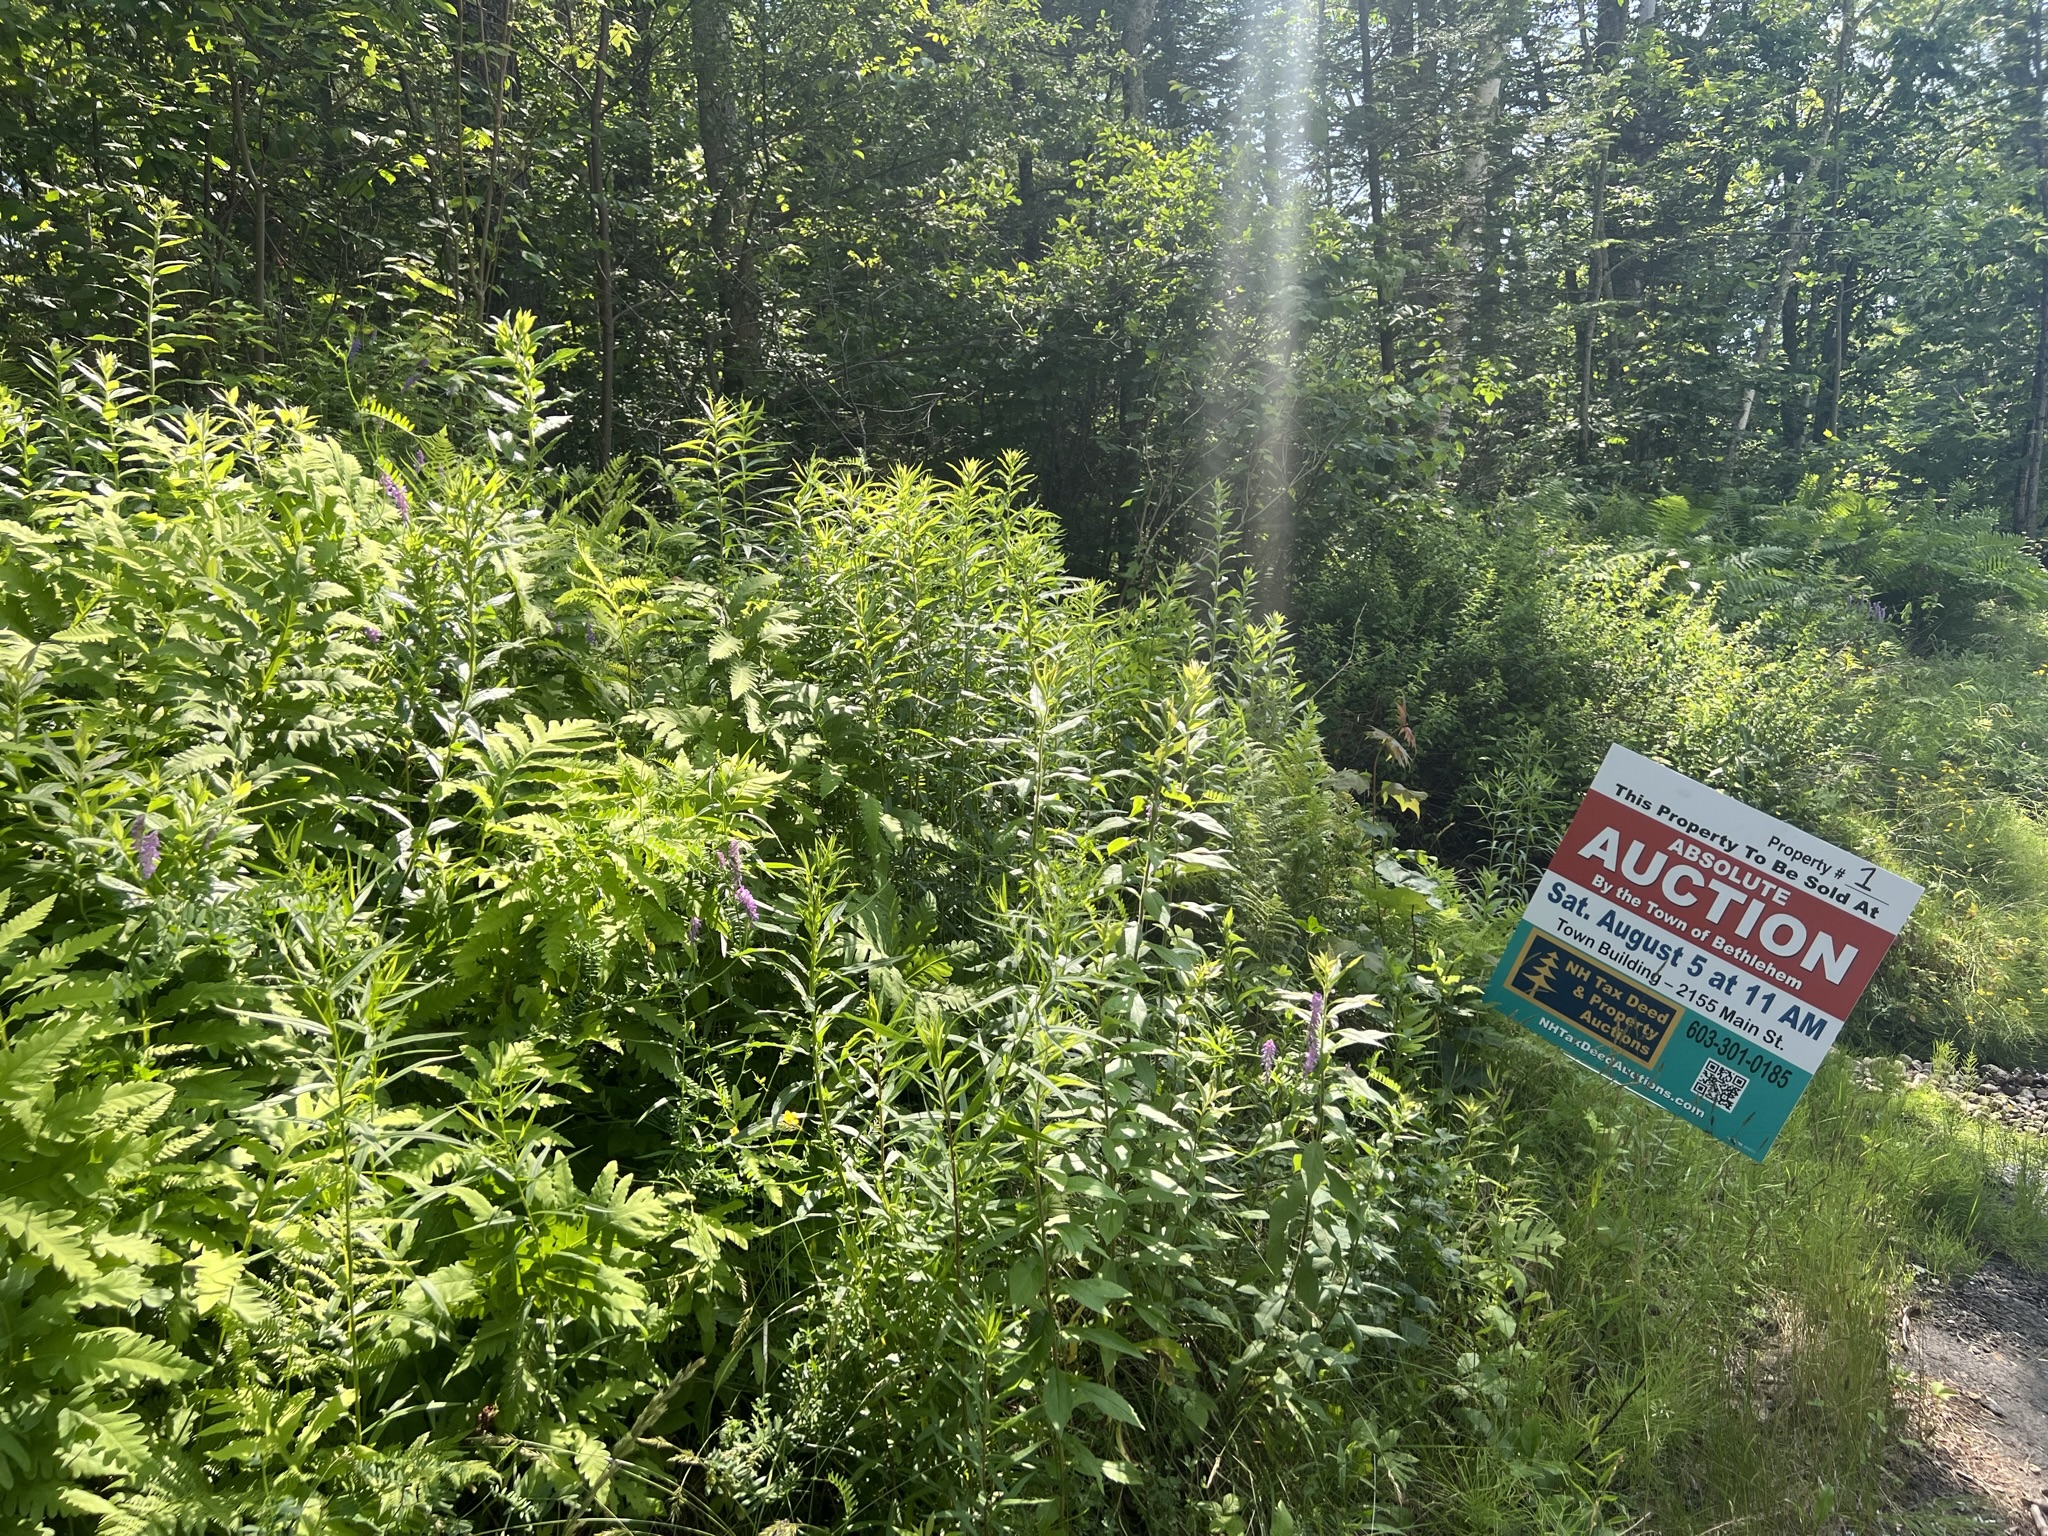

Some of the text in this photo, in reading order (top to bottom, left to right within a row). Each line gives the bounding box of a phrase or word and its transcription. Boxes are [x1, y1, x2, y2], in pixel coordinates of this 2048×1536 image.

[1615, 783, 1880, 919] This Property To Be Sold At
[1667, 838, 1791, 906] ABSOLUTE
[1767, 836, 1846, 879] Property #
[1854, 867, 1877, 892] 1
[1577, 825, 1859, 986] AUCTION
[1591, 873, 1803, 991] By the Town of Bethlehem
[1547, 881, 1828, 1041] Sat. August 5 at 11 AM
[1556, 917, 1595, 949] Town
[1597, 941, 1662, 986] Building
[1676, 983, 1719, 1013] 2155
[1718, 1005, 1760, 1037] Main
[1762, 1030, 1784, 1051] St.
[1565, 960, 1670, 1025] NH Tax Deed
[1572, 985, 1660, 1042] & Property
[1579, 1009, 1650, 1056] Auctions
[1686, 1020, 1793, 1089] 603-301-0185
